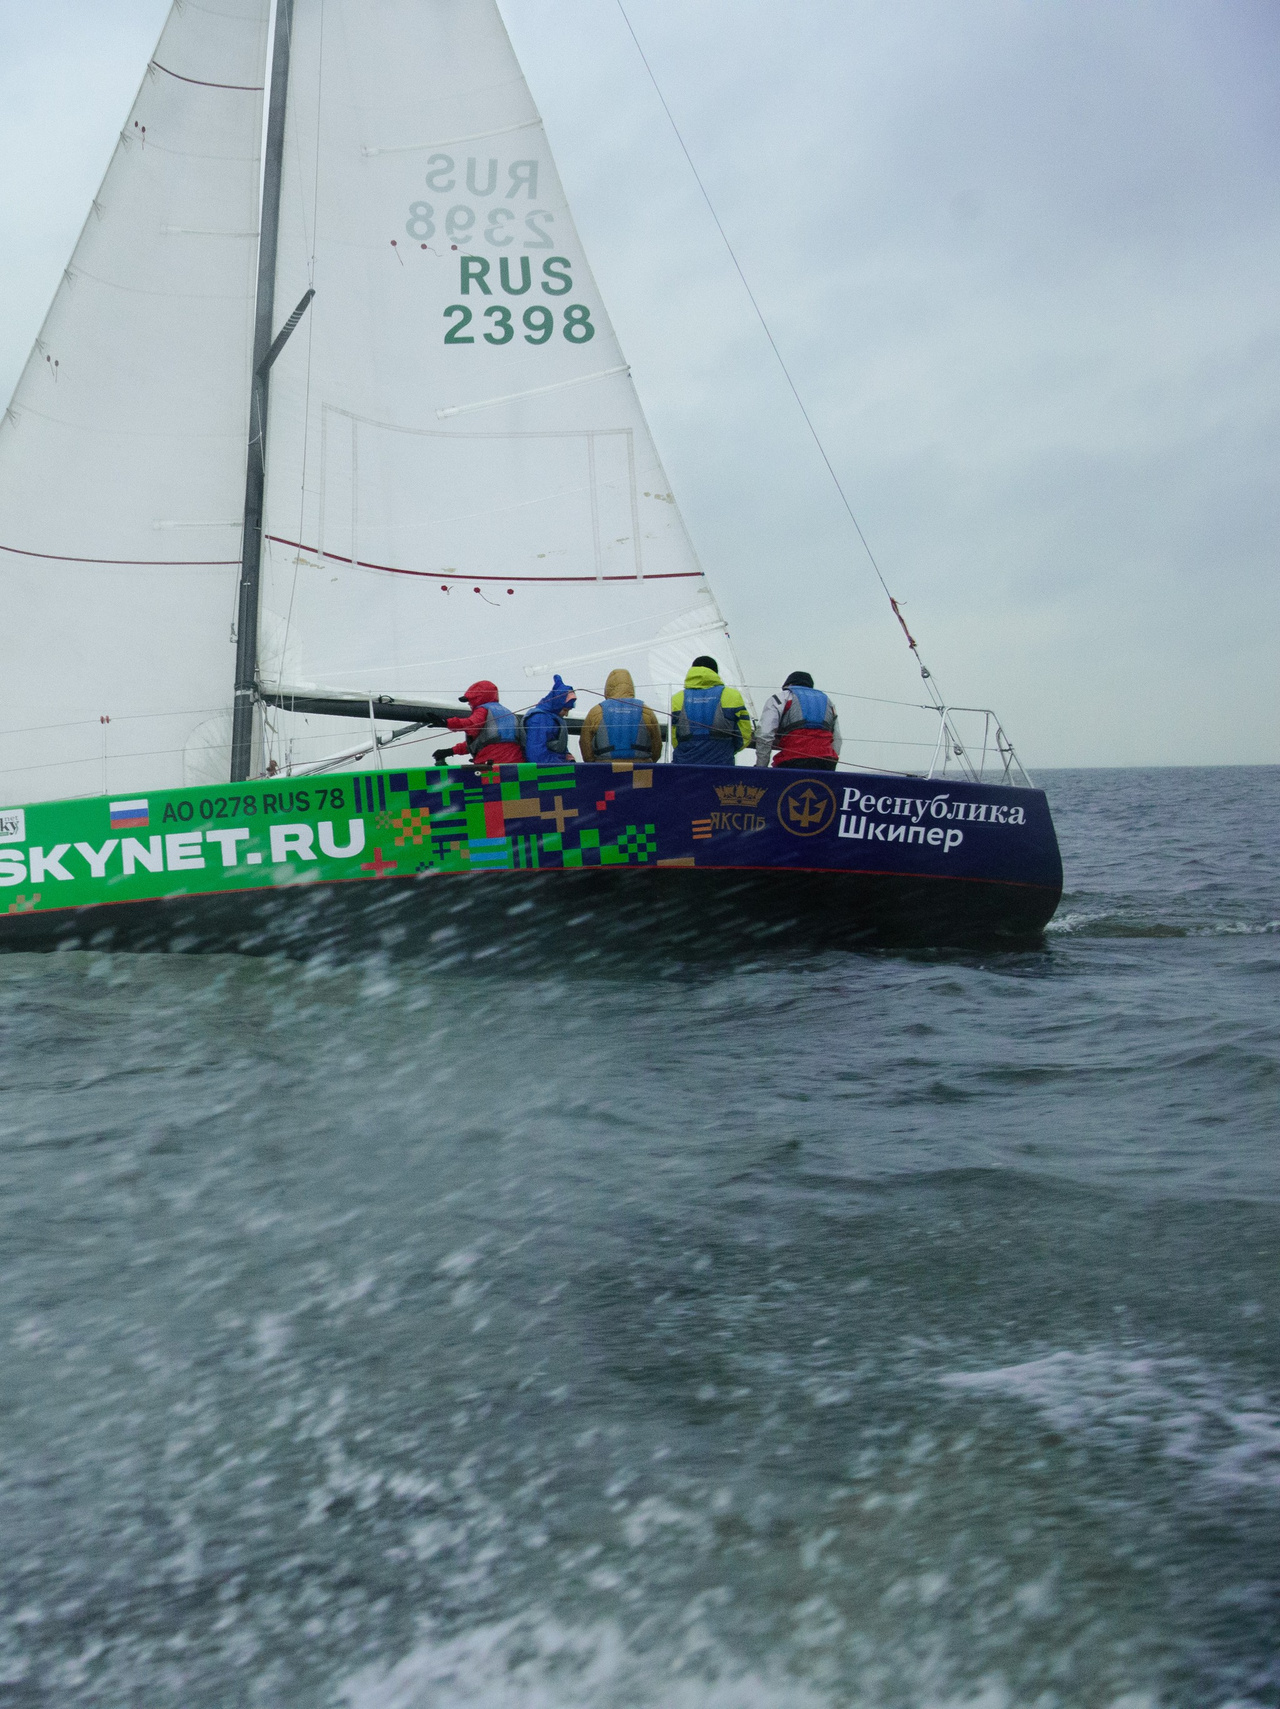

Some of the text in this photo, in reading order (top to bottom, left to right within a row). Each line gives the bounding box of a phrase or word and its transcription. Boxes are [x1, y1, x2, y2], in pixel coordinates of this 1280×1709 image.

[460, 256, 573, 297] RUS
[443, 304, 595, 345] 2398
[199, 794, 258, 820] 0278
[840, 787, 1026, 825] Республика
[838, 814, 963, 853] Шкипер
